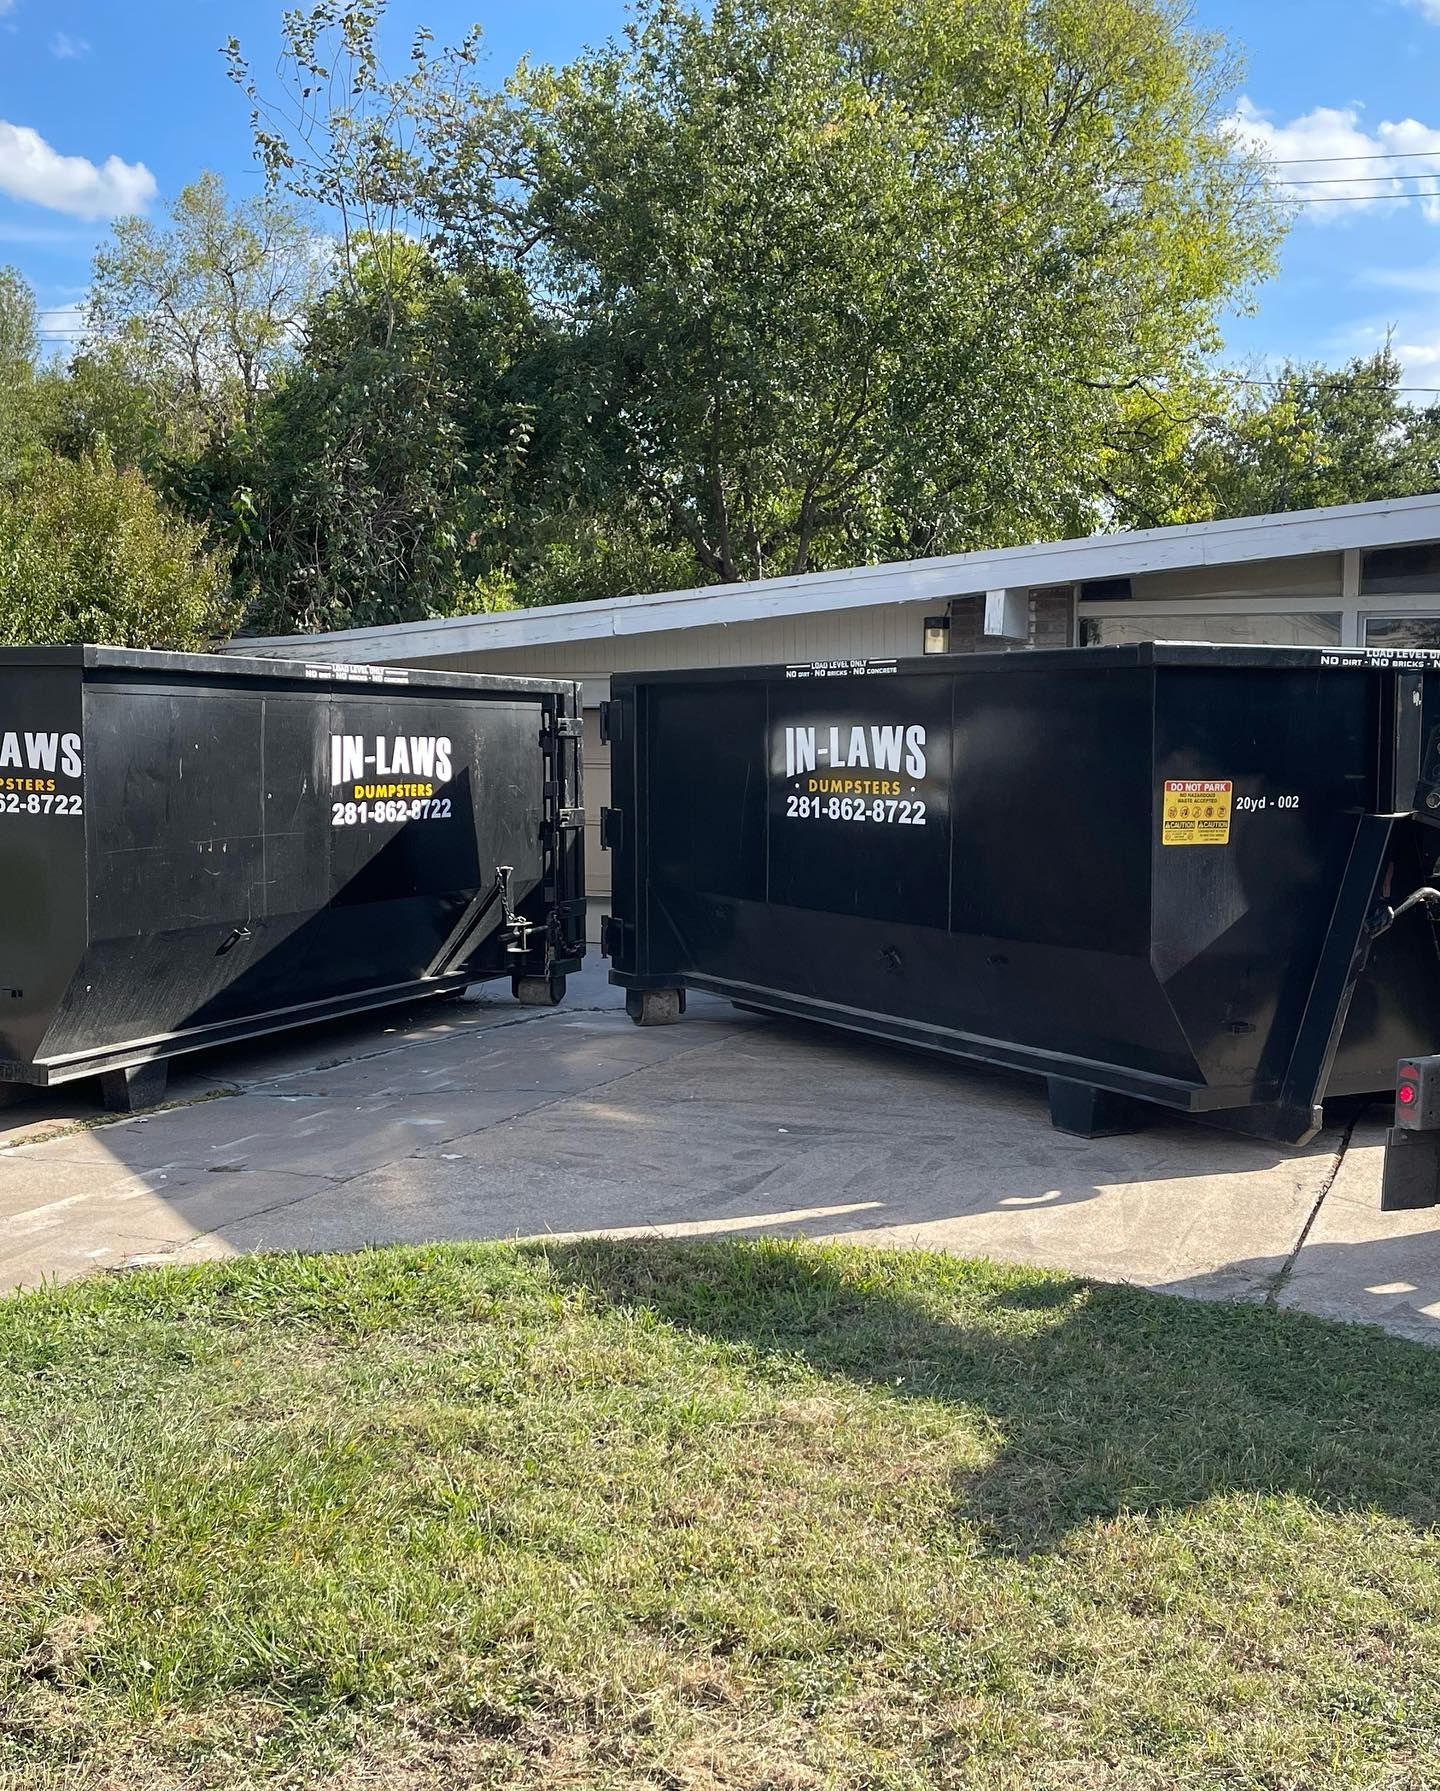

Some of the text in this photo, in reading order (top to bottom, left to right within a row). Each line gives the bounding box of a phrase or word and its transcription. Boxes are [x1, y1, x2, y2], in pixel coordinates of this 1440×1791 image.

[1366, 649, 1393, 658] LOAD
[1396, 650, 1427, 659] LEVEL
[811, 660, 867, 670] LOAD LEVEL ONLY
[1320, 656, 1339, 665] NO
[1371, 658, 1389, 667] NO
[1392, 660, 1424, 668] BRICKS
[305, 669, 318, 678] NO
[335, 672, 347, 680] NO
[372, 674, 384, 682] NO
[786, 670, 797, 678] NO
[814, 669, 826, 677] NO
[853, 667, 865, 675] NO
[866, 667, 898, 675] CONCRETE
[785, 724, 926, 780] IN-LAWS
[331, 735, 452, 786] IN-LAWS
[354, 783, 433, 799] DUMPSTERS
[808, 779, 901, 796] DUMPSTERS
[1170, 783, 1226, 791] DO NOT PARK
[786, 795, 926, 825] 281-862-8722
[1235, 796, 1266, 813] 20yd
[1277, 795, 1299, 809] 002
[331, 798, 452, 826] 281-862-8722
[1170, 821, 1195, 829] CAUTION
